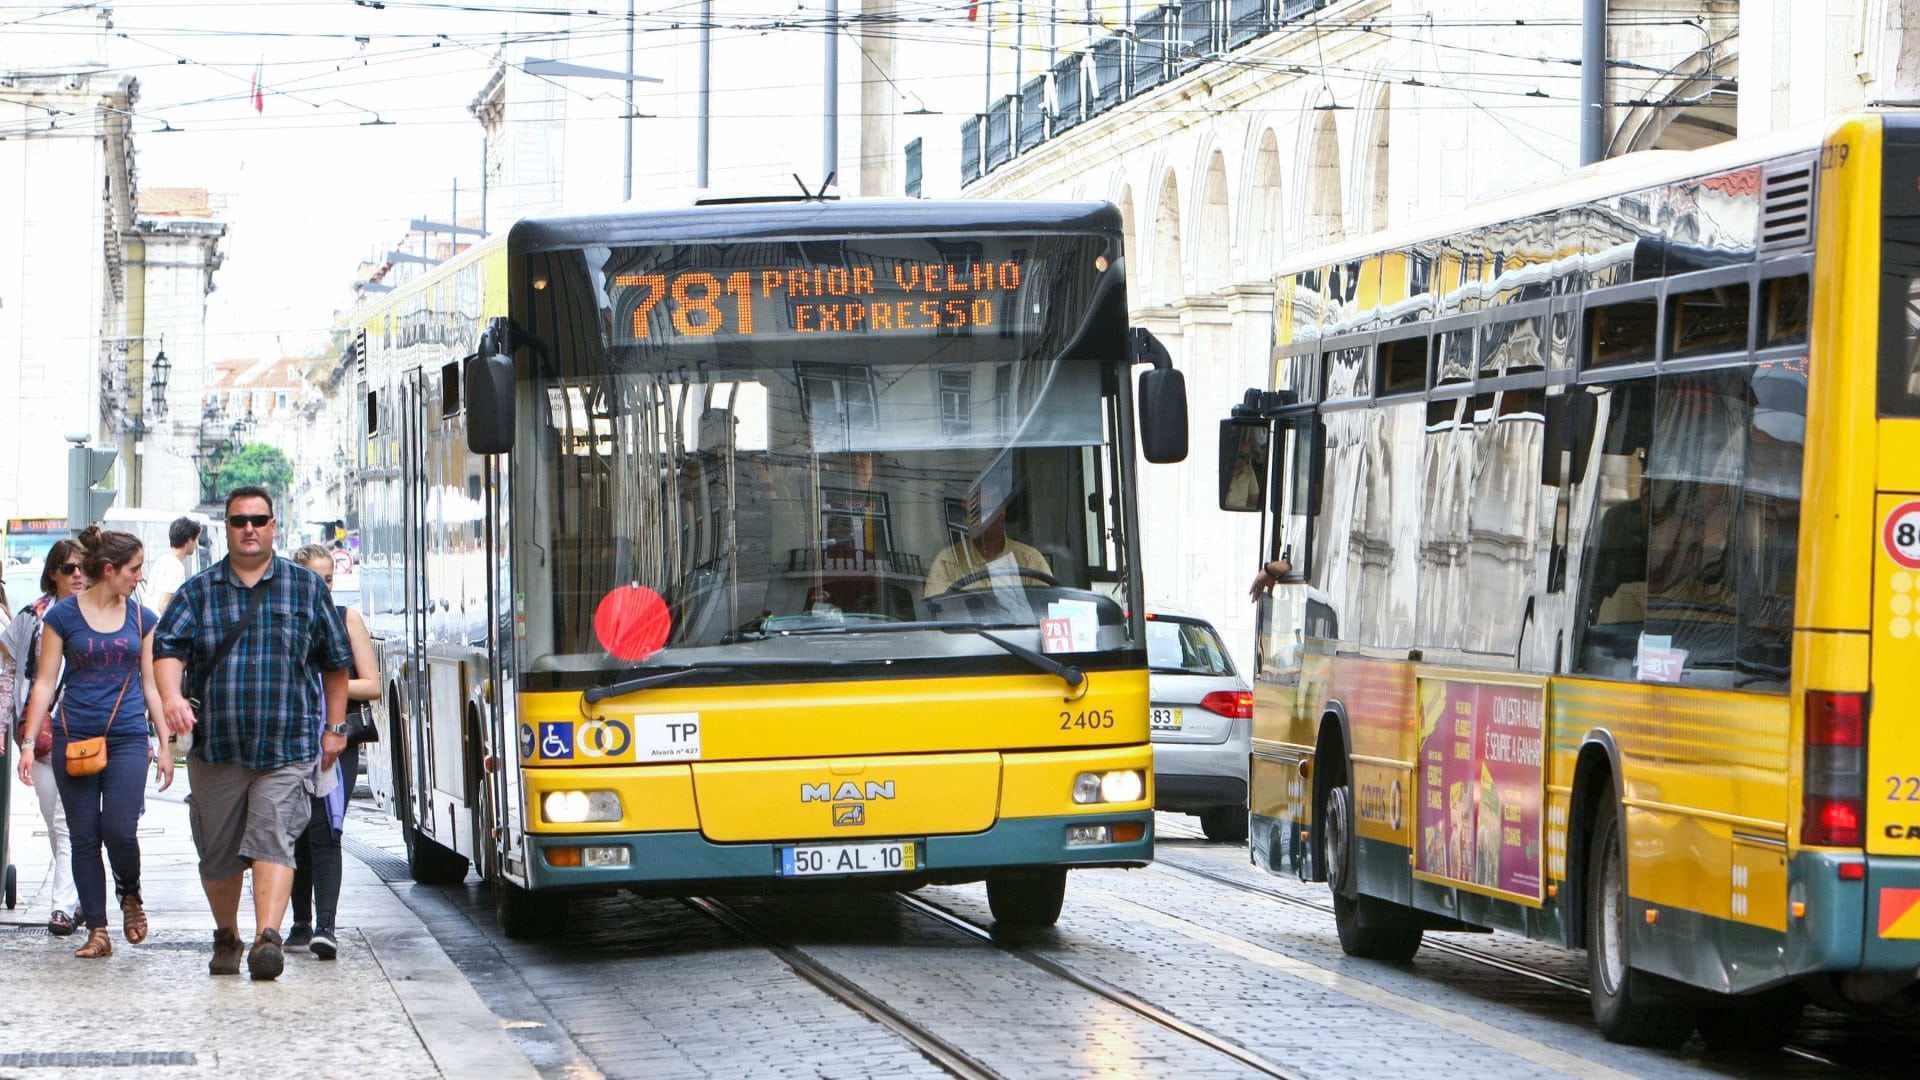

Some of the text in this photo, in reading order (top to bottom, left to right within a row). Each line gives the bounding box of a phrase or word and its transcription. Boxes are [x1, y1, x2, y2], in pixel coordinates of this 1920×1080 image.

[762, 262, 1020, 298] PRIOR VELHO
[615, 271, 753, 338] 781
[796, 299, 992, 332] EXPRESSO
[1897, 522, 1920, 547] 8
[1046, 622, 1068, 637] 781
[1059, 710, 1115, 730] 2405
[666, 723, 698, 743] TP
[801, 780, 895, 803] MAN
